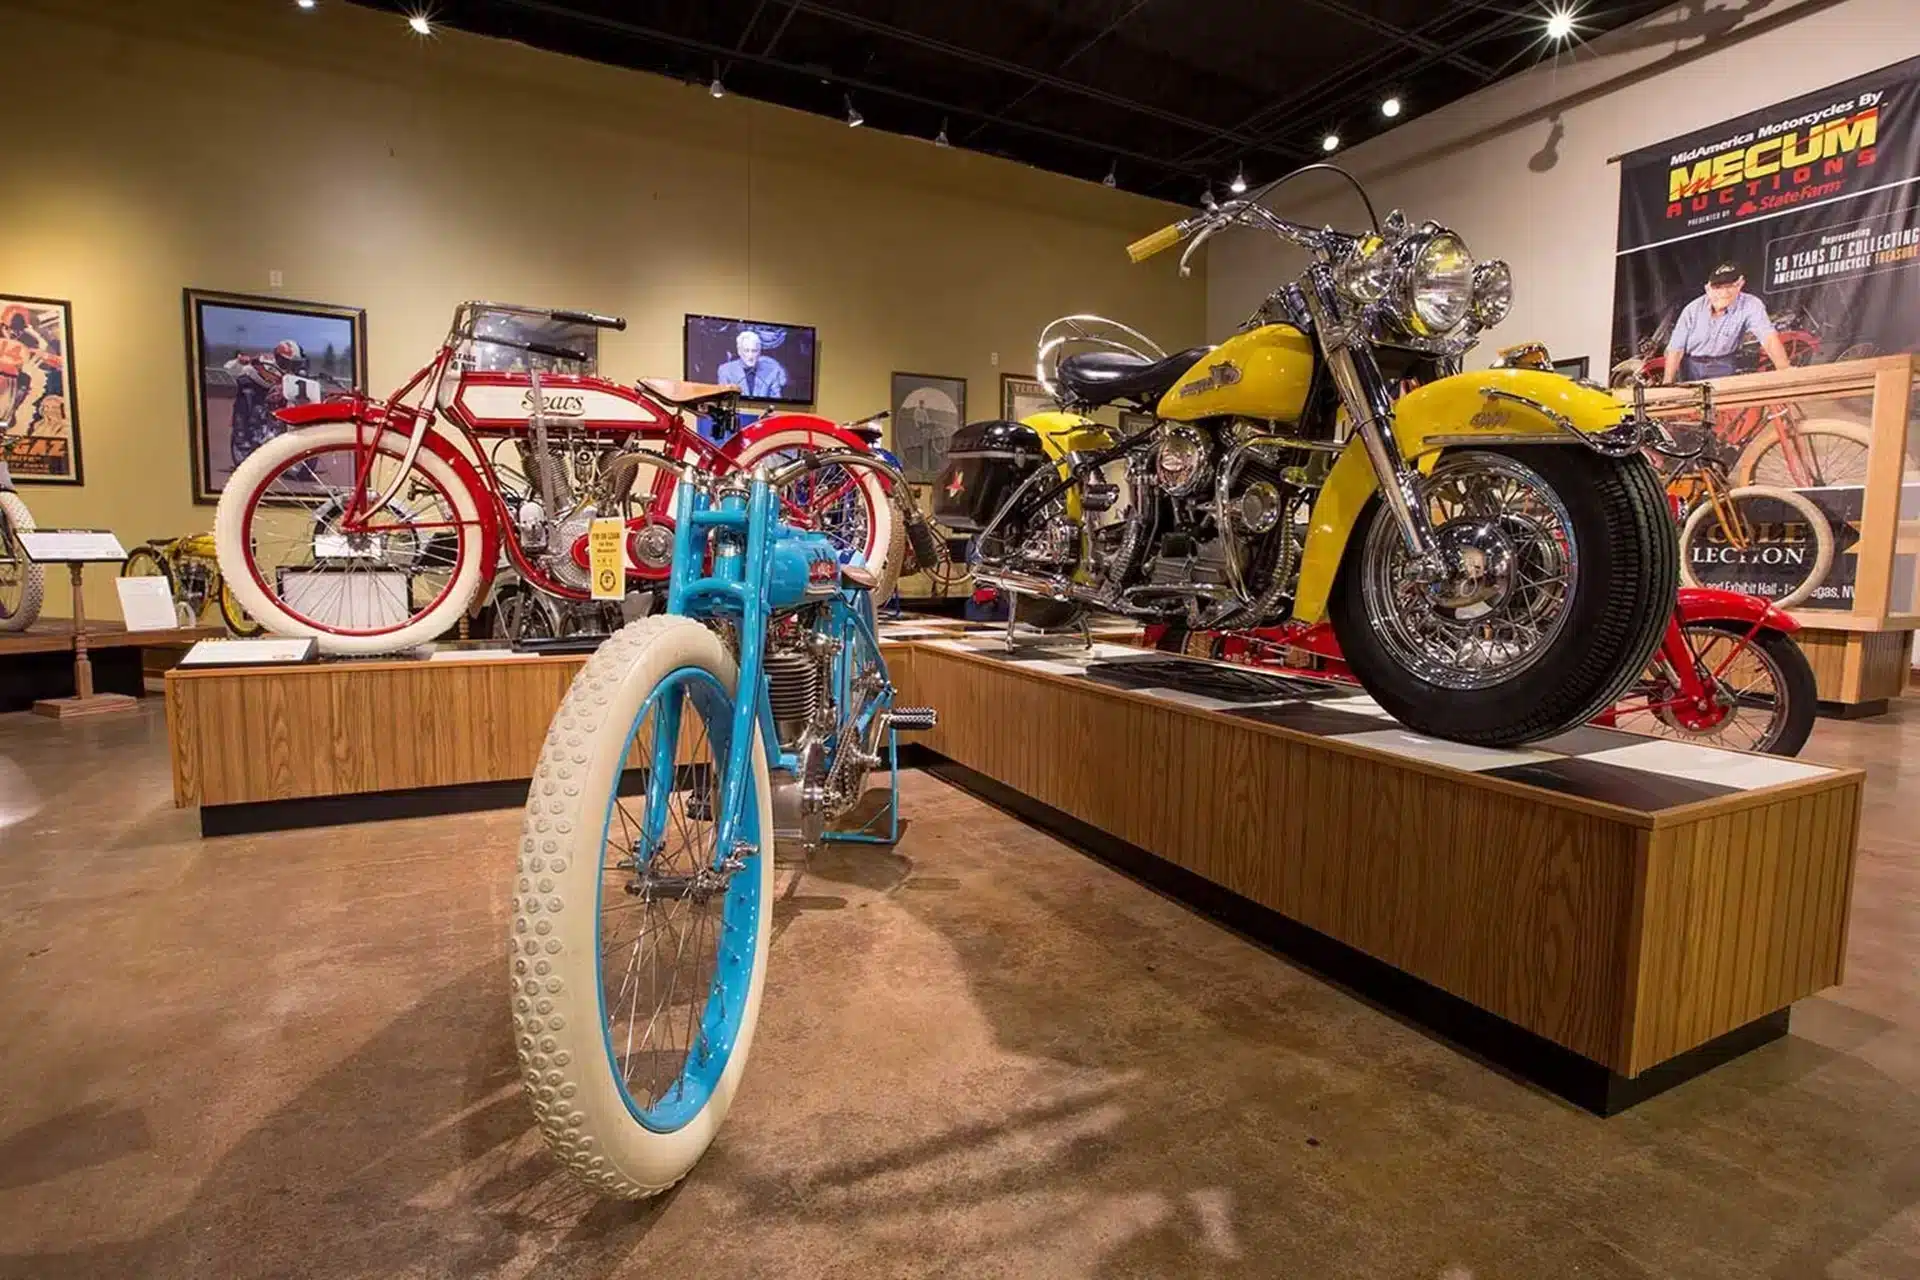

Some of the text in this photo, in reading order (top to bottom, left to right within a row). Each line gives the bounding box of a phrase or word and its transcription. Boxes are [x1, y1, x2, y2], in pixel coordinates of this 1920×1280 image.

[1670, 91, 1884, 167] MidAmerica Motorcycles By
[1669, 107, 1880, 202] MECUM
[1666, 148, 1878, 218] AUCTIONS
[1774, 227, 1920, 273] 50 YEARS OF COLLECTING
[1773, 266, 1814, 286] AMERICAN
[1816, 254, 1872, 276] MOTORCYCLE
[520, 388, 584, 412] Sears
[1706, 521, 1807, 544] CLE
[1758, 583, 1778, 596] Hall
[1810, 587, 1840, 600] egas,
